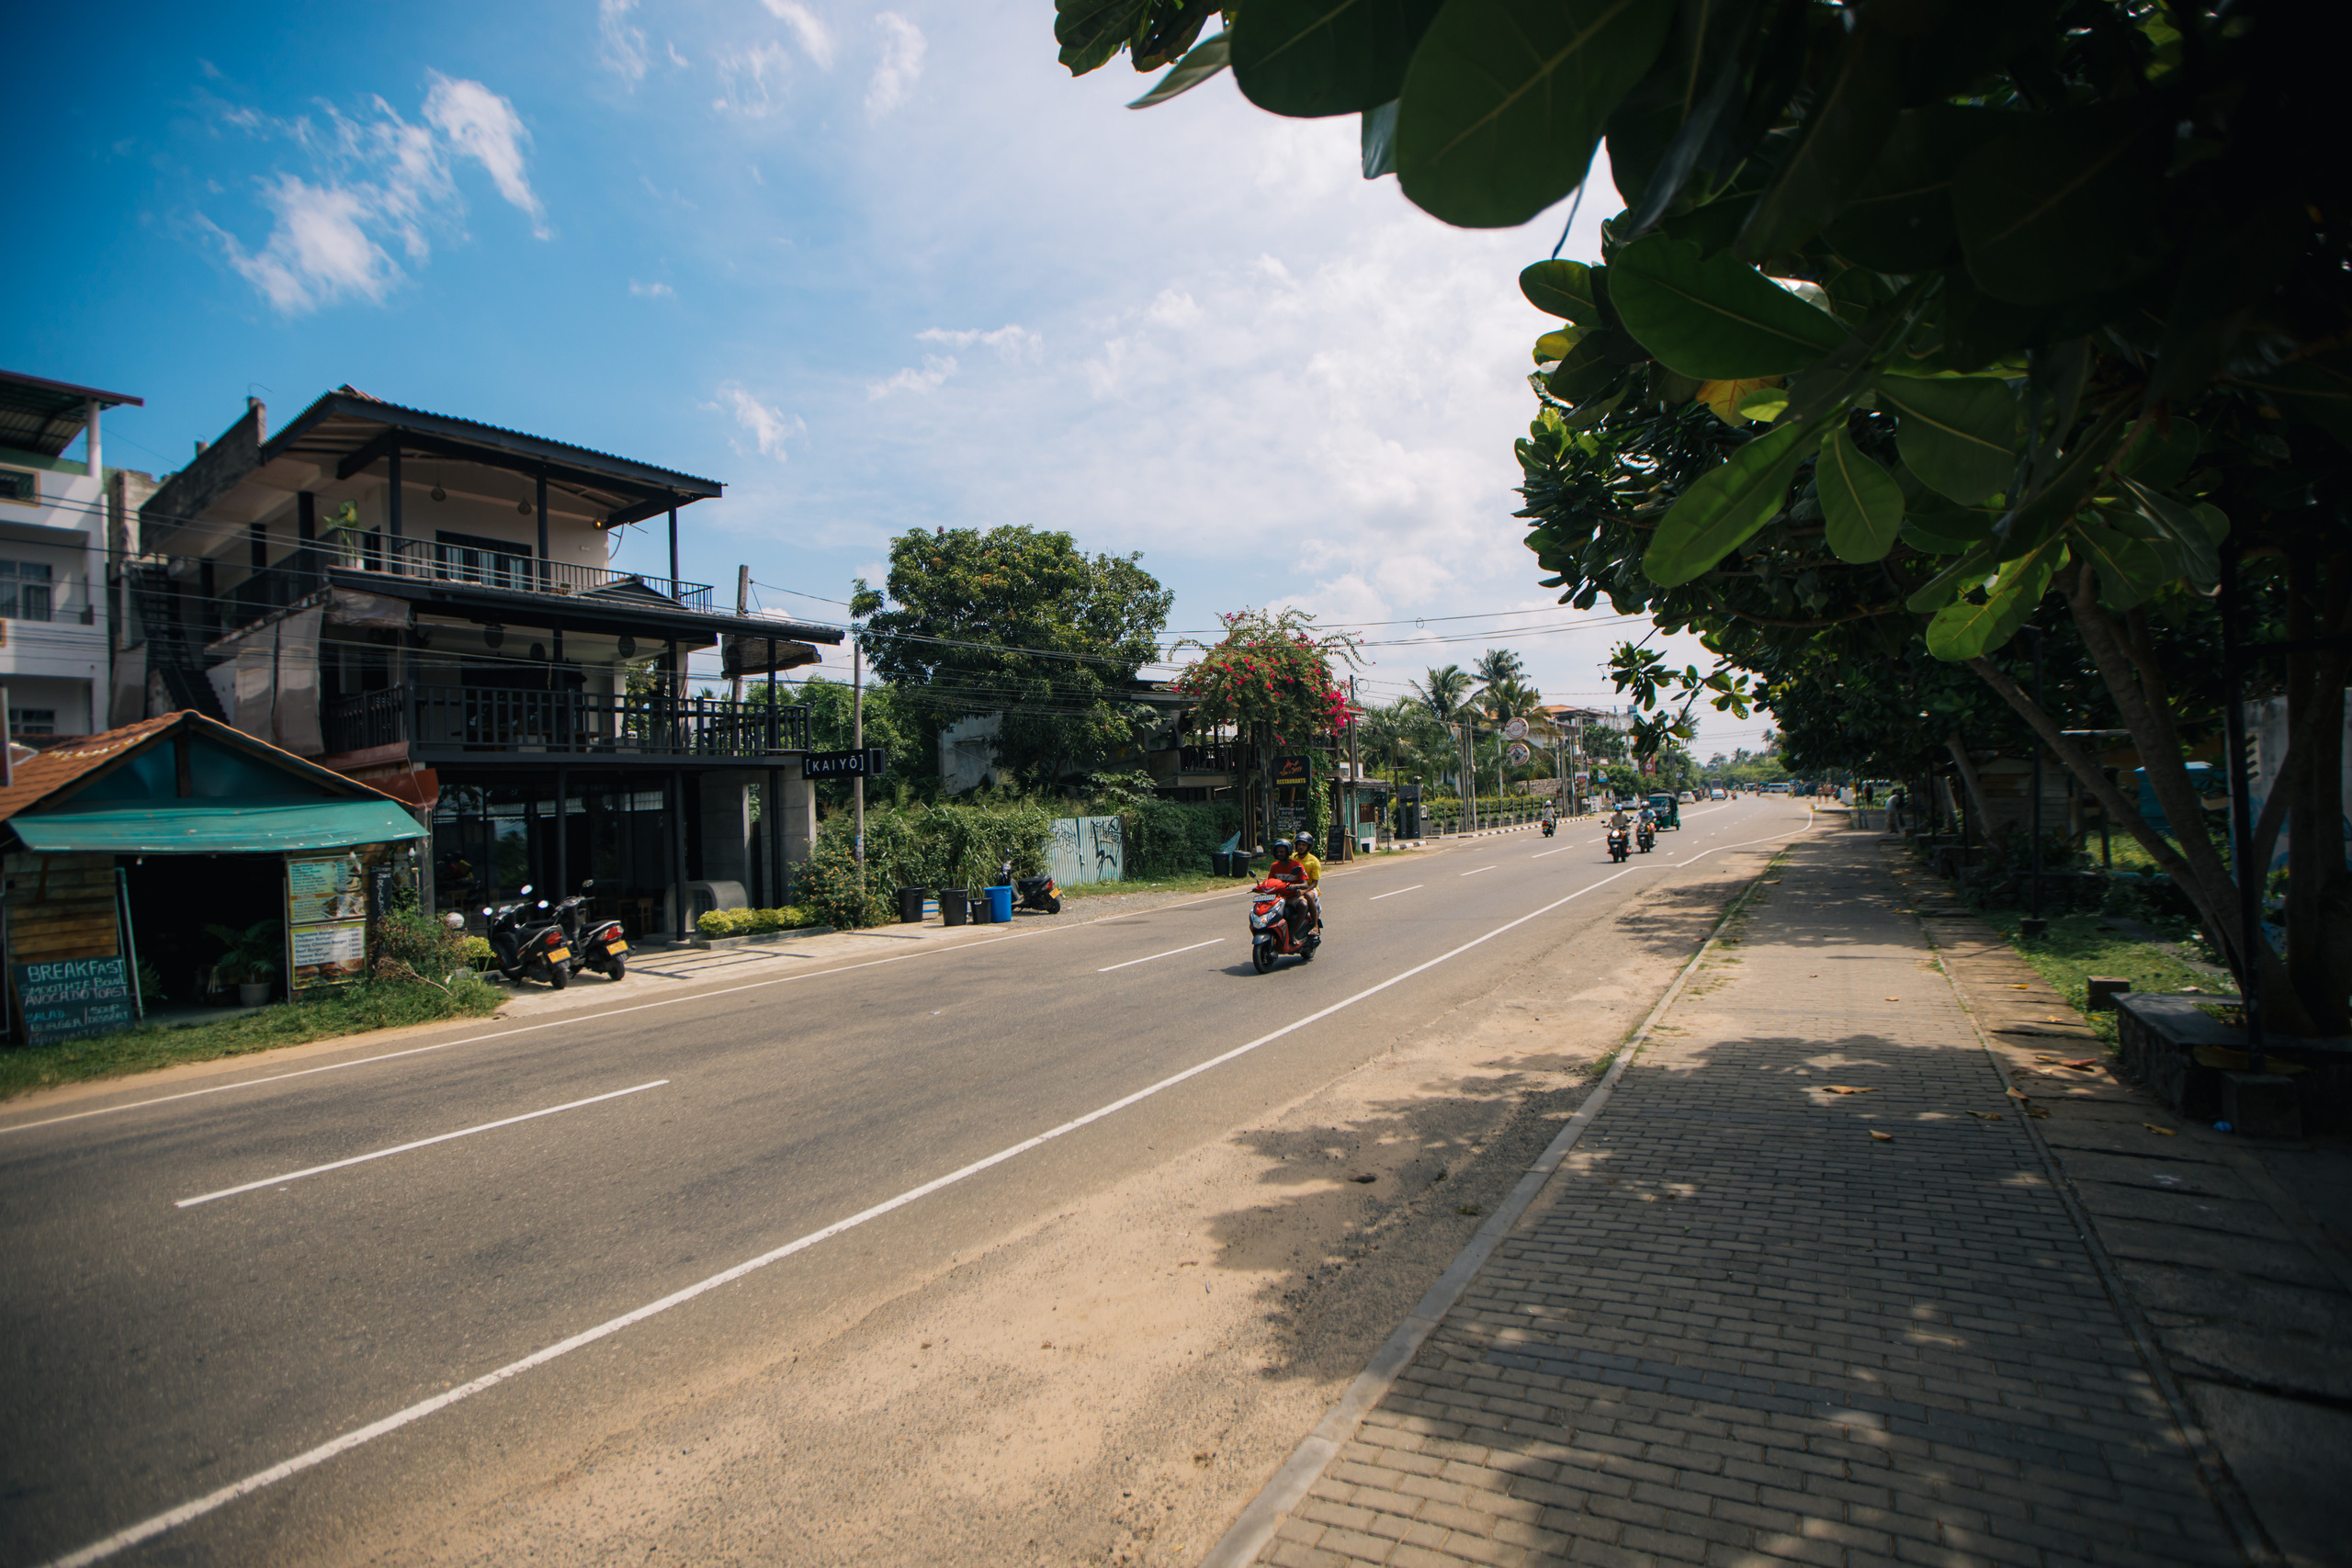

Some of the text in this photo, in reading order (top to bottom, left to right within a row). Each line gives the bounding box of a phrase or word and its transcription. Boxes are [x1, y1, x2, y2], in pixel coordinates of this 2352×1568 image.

[28, 960, 123, 982] BREAKFAST
[20, 979, 90, 996] SMOOTHIE
[25, 986, 128, 1007] AVOCADO TOAST
[90, 1004, 119, 1014] SOUP
[25, 1010, 65, 1023] SALAD
[87, 1011, 128, 1023] DESSERT
[30, 1018, 84, 1032] BURGER
